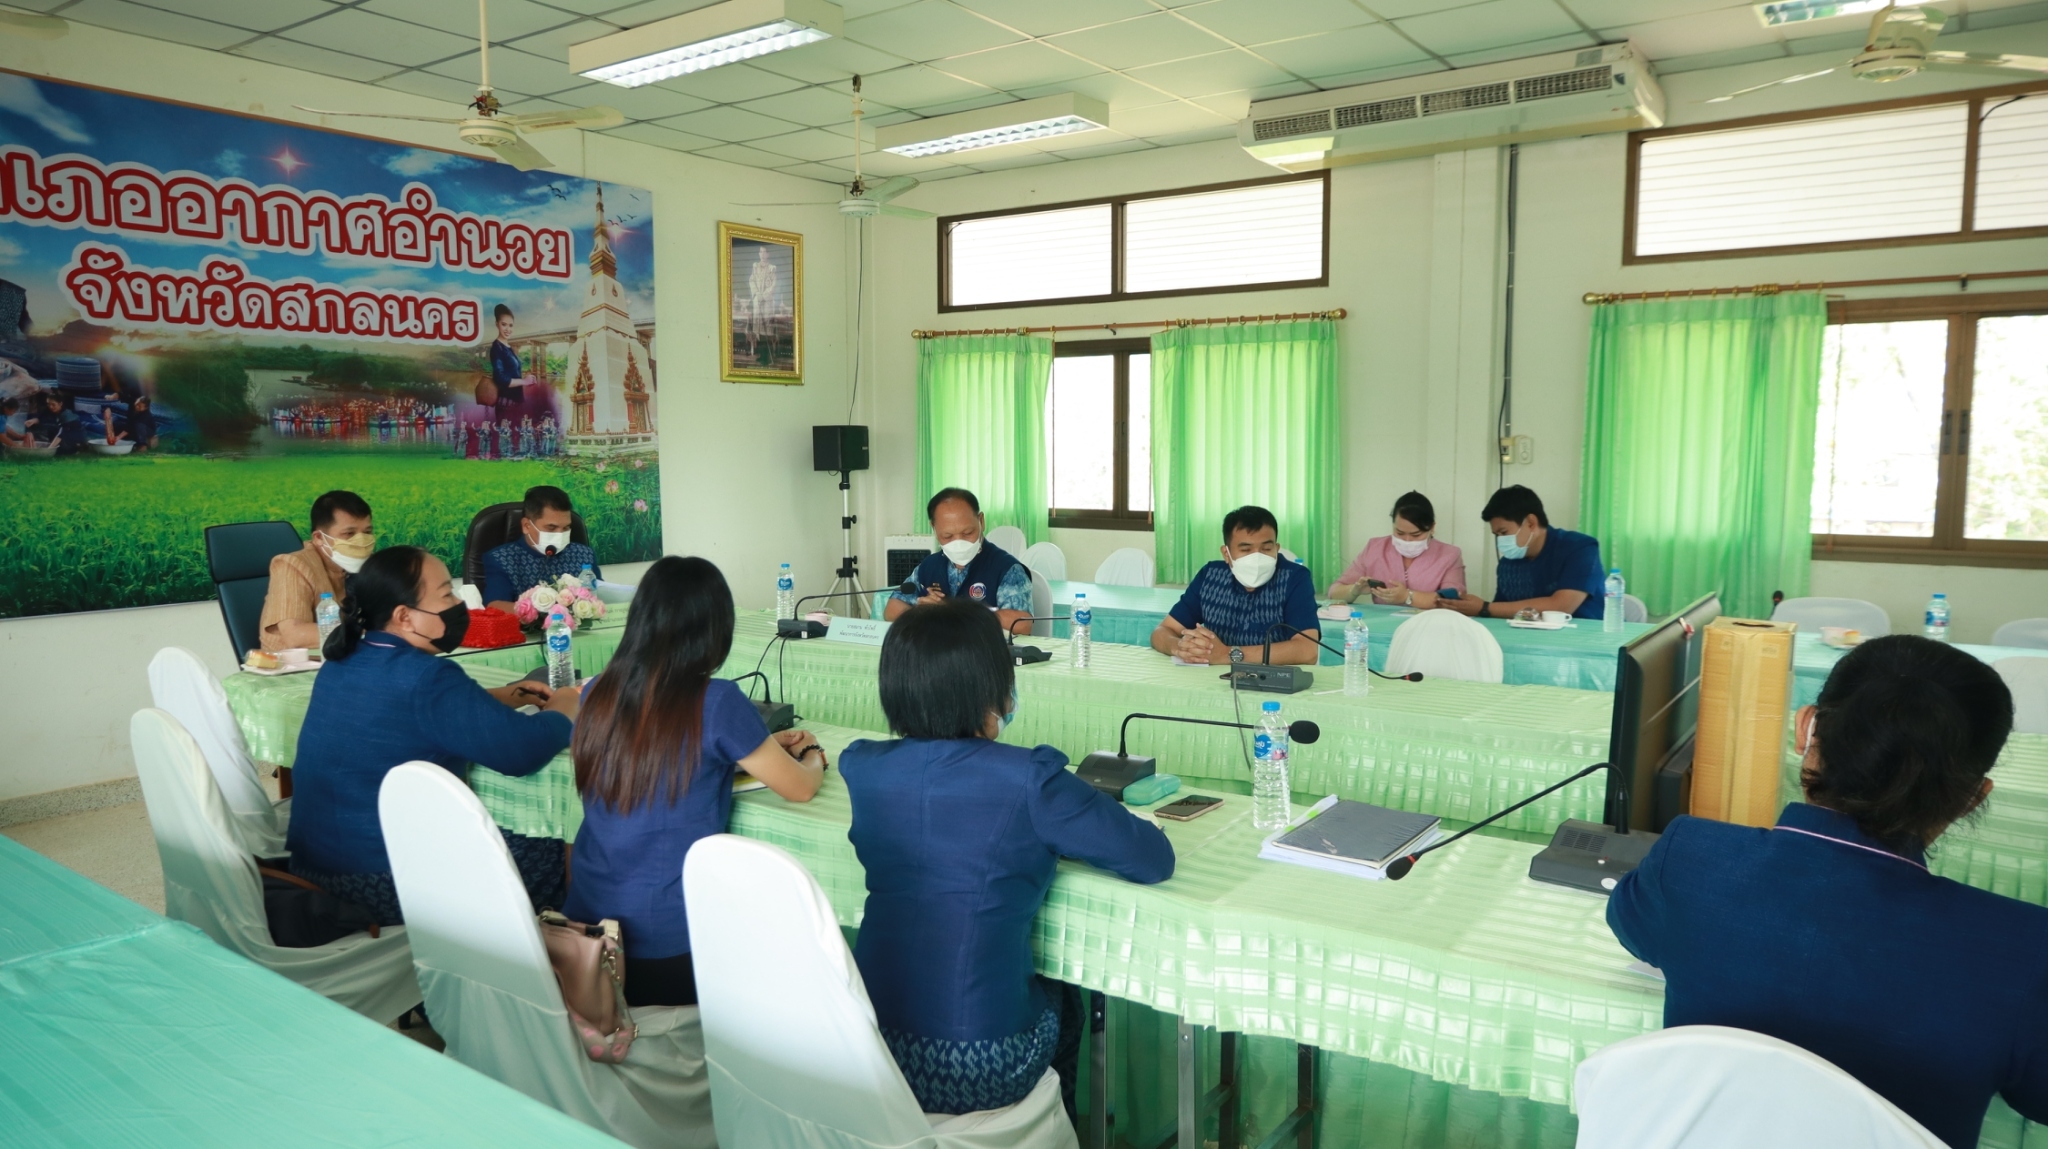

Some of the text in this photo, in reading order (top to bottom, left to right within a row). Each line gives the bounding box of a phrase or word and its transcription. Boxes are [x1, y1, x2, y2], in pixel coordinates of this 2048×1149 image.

[0, 152, 572, 278] เภออากาศอำนวย
[68, 247, 480, 340] จังหวัดสกลนคร
